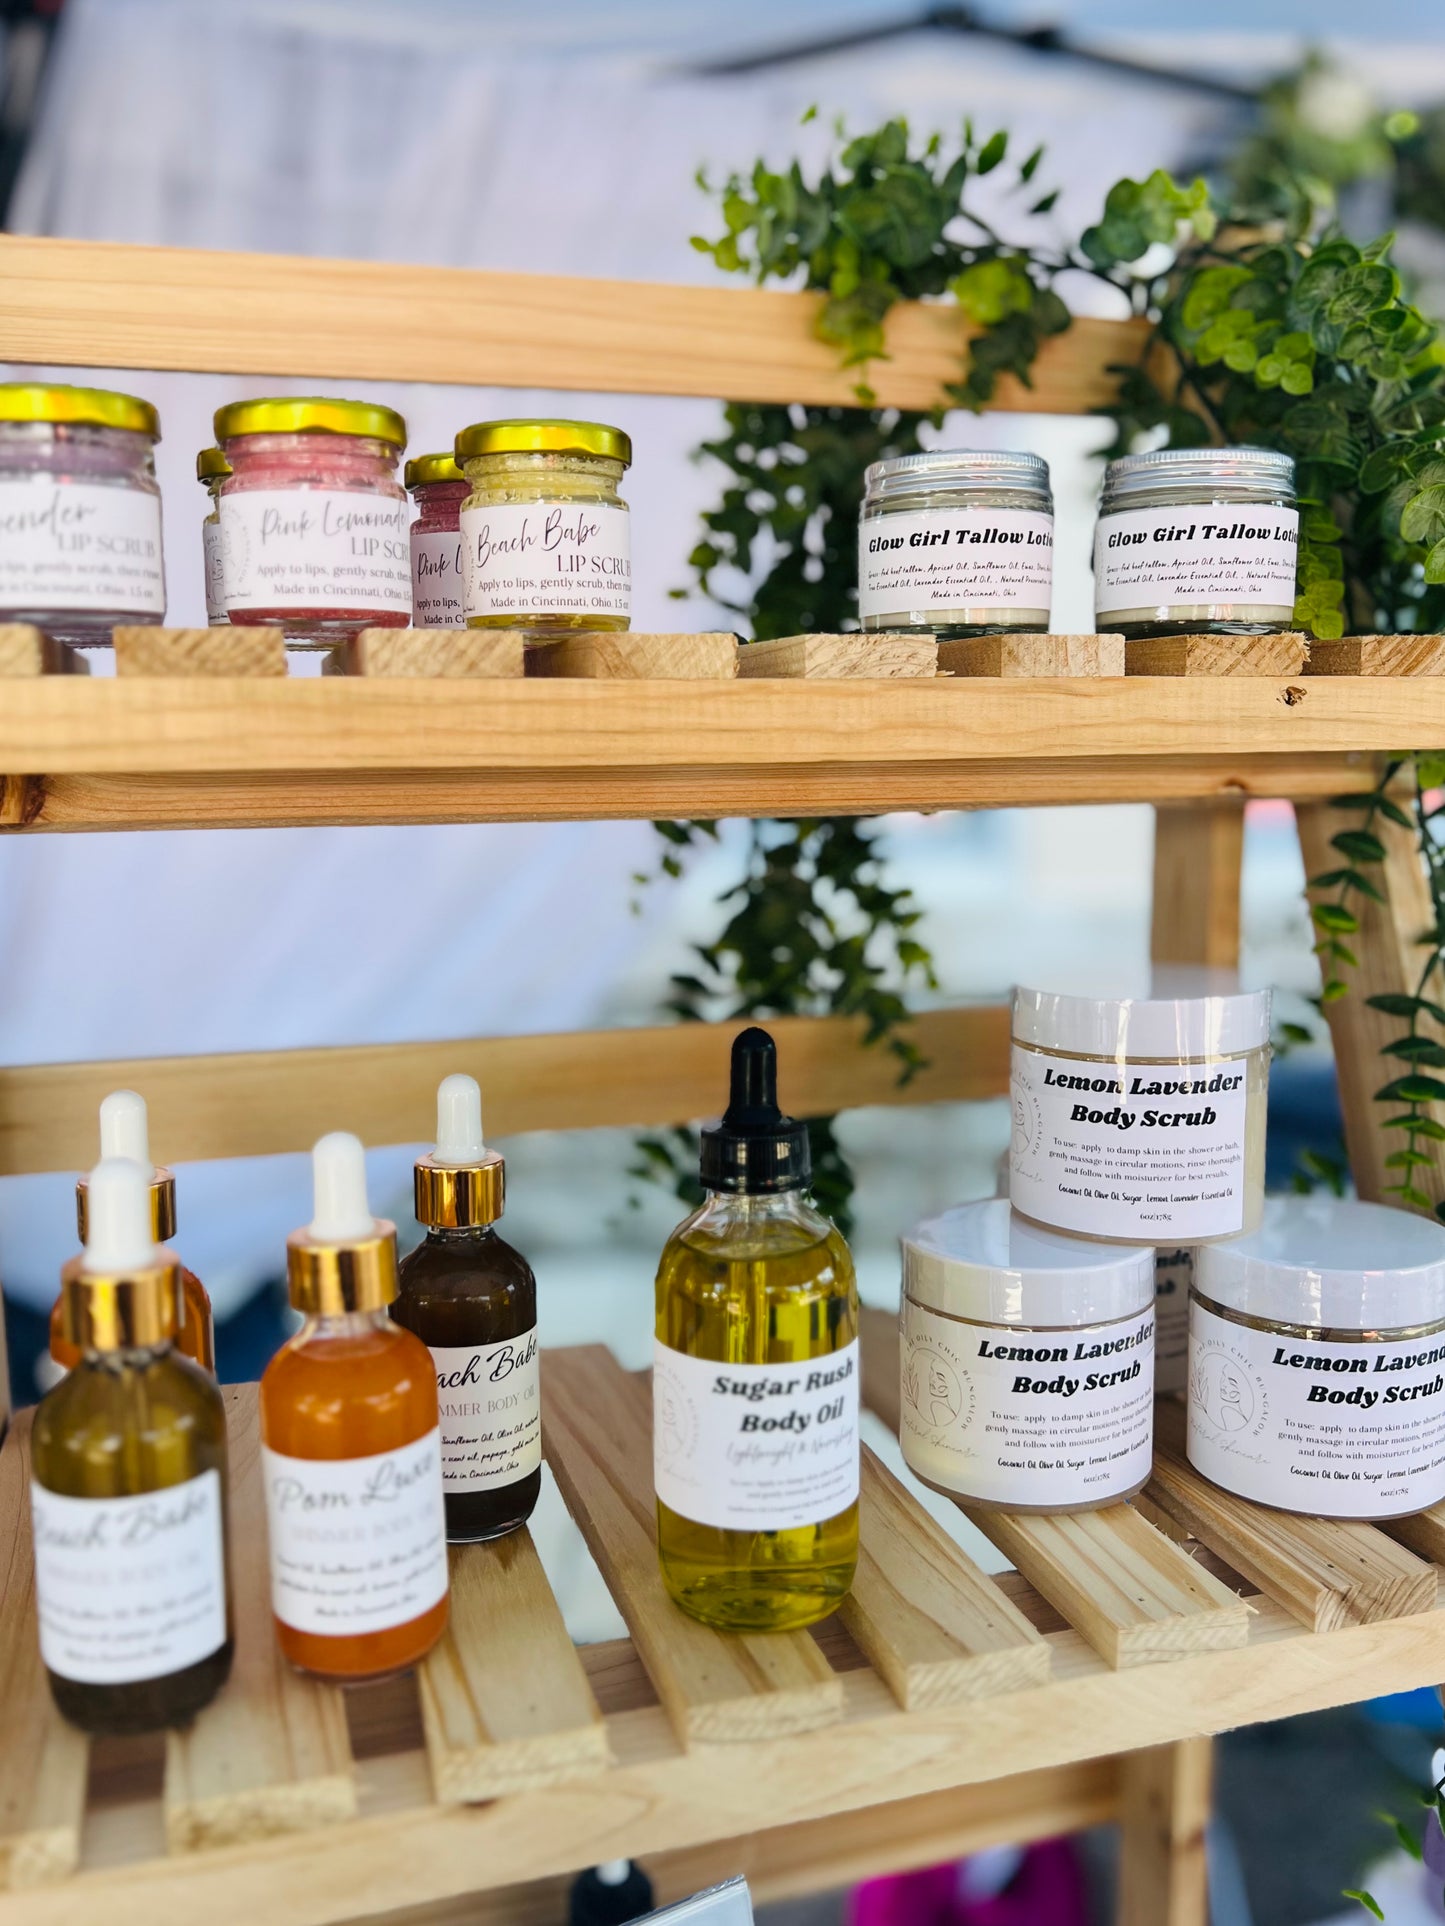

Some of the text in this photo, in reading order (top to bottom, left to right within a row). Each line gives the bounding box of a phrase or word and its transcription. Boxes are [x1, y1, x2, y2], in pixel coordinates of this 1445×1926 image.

[0, 488, 96, 536] ender
[260, 508, 316, 544] Pink
[477, 518, 537, 568] Beach
[541, 508, 601, 551] Babe
[869, 537, 904, 553] Glow
[910, 530, 950, 547] Girl
[956, 529, 1024, 544] Tallow
[1109, 532, 1147, 548] Glow
[1153, 525, 1196, 542] Girl
[1203, 524, 1271, 540] Tallow
[352, 537, 379, 556] LIP
[258, 564, 287, 577] Apply
[290, 565, 302, 573] to
[306, 564, 328, 577] lips,
[333, 564, 367, 578] gently
[418, 553, 450, 584] Pink
[557, 555, 586, 573] LIP
[928, 564, 954, 574] Apricot
[973, 562, 1006, 571] Sunflower
[1172, 559, 1199, 569] Apricot
[1219, 557, 1253, 566] Sunflower
[914, 579, 943, 587] Lavender
[945, 576, 978, 585] Essential
[1001, 576, 1024, 584] Natural
[1157, 573, 1188, 582] Lavender
[1190, 571, 1223, 580] Essential
[1247, 571, 1270, 579] Natural
[274, 584, 304, 594] Made
[309, 584, 320, 594] in
[323, 585, 382, 598] Cincinnati,
[479, 580, 501, 593] Apply
[503, 580, 513, 589] to
[516, 578, 538, 590] lips,
[540, 578, 573, 590] gently
[577, 579, 605, 590] scrub,
[931, 591, 950, 599] Made
[1003, 589, 1017, 597] Ohio
[1175, 586, 1195, 594] Made
[1249, 585, 1262, 593] Ohio
[443, 598, 460, 609] lips,
[491, 598, 515, 608] Made
[519, 598, 529, 607] in
[532, 598, 589, 609] Cincinnati,
[424, 615, 443, 624] Made
[445, 615, 453, 624] in
[1044, 1069, 1243, 1096] Lemon Lavender
[1070, 1104, 1217, 1130] Body Scrub
[1054, 1137, 1062, 1146] To
[1081, 1144, 1102, 1154] apply
[1117, 1147, 1141, 1156] damp
[1143, 1148, 1160, 1156] skin
[1163, 1148, 1171, 1156] in
[1174, 1147, 1186, 1155] the
[1189, 1147, 1215, 1155] shower
[1049, 1151, 1068, 1161] gently
[1071, 1155, 1103, 1166] massage
[1151, 1161, 1186, 1169] motions,
[1065, 1167, 1078, 1175] and
[1080, 1168, 1102, 1178] follow
[1125, 1174, 1172, 1182] moisturizer
[1059, 1184, 1082, 1196] Coconut
[1084, 1188, 1093, 1197] Oil
[1095, 1190, 1109, 1199] Olive
[1111, 1192, 1120, 1201] Oil
[1147, 1194, 1169, 1203] Lemon
[1171, 1194, 1199, 1203] Lavender
[1202, 1190, 1226, 1200] Essential
[978, 1340, 1068, 1362] Lemon
[1073, 1321, 1154, 1361] Lavender
[437, 1334, 537, 1389] ach Babe
[1272, 1348, 1368, 1373] Lemon
[712, 1357, 853, 1402] Sugar Rush
[1012, 1360, 1141, 1397] Body Scrub
[1307, 1375, 1444, 1409] Body Scrub
[488, 1392, 520, 1413] BODY
[740, 1396, 845, 1434] Body Oil
[1025, 1414, 1084, 1424] apply damp
[442, 1436, 479, 1446] Sunflower
[497, 1430, 513, 1440] Olive
[1012, 1427, 1047, 1438] massage
[1320, 1425, 1383, 1434] apply damp
[1024, 1441, 1047, 1449] follow
[1306, 1437, 1343, 1447] massage
[998, 1458, 1025, 1469] Coconut
[1318, 1450, 1364, 1460] follow with
[1291, 1466, 1319, 1478] Coconut
[273, 1476, 350, 1514] Pom
